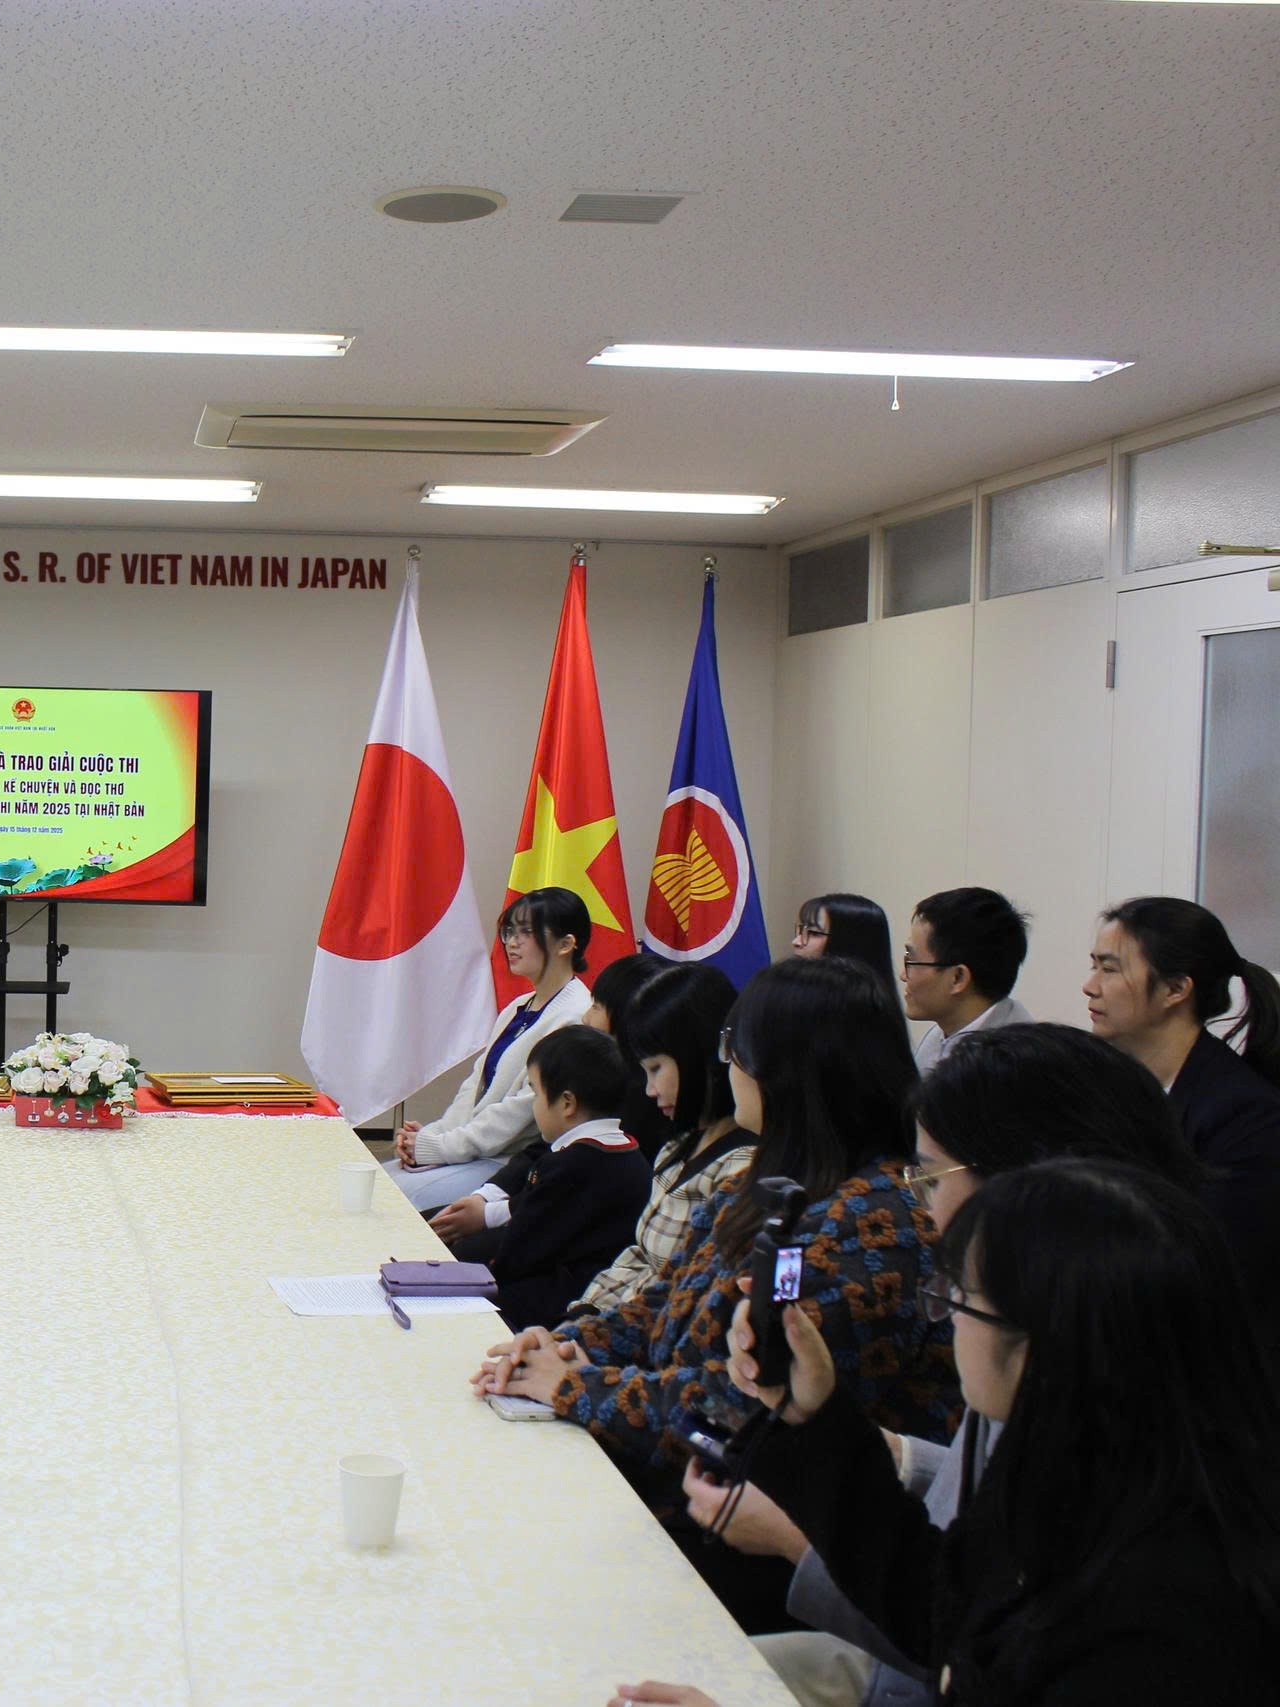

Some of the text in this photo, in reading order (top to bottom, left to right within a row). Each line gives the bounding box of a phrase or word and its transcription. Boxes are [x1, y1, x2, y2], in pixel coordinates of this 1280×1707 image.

[3, 551, 29, 582] S.
[38, 552, 67, 583] R.
[76, 552, 112, 584] OF
[121, 553, 182, 584] VIET
[190, 555, 253, 587] NAM
[260, 557, 289, 588] IN
[297, 557, 387, 589] JAPAN
[11, 755, 44, 771] TRAO
[49, 751, 74, 772] GIẢI
[80, 753, 114, 776] CUỘC
[118, 757, 139, 773] THI
[19, 778, 60, 797] CHUYỆN
[63, 779, 77, 795] VÀ
[80, 782, 101, 798] ĐỌC
[105, 782, 125, 796] THƠ
[15, 799, 39, 815] NĂM
[43, 803, 71, 816] 2025
[75, 803, 91, 819] TẠI
[94, 801, 121, 819] NHẬT
[124, 801, 146, 817] BẢN
